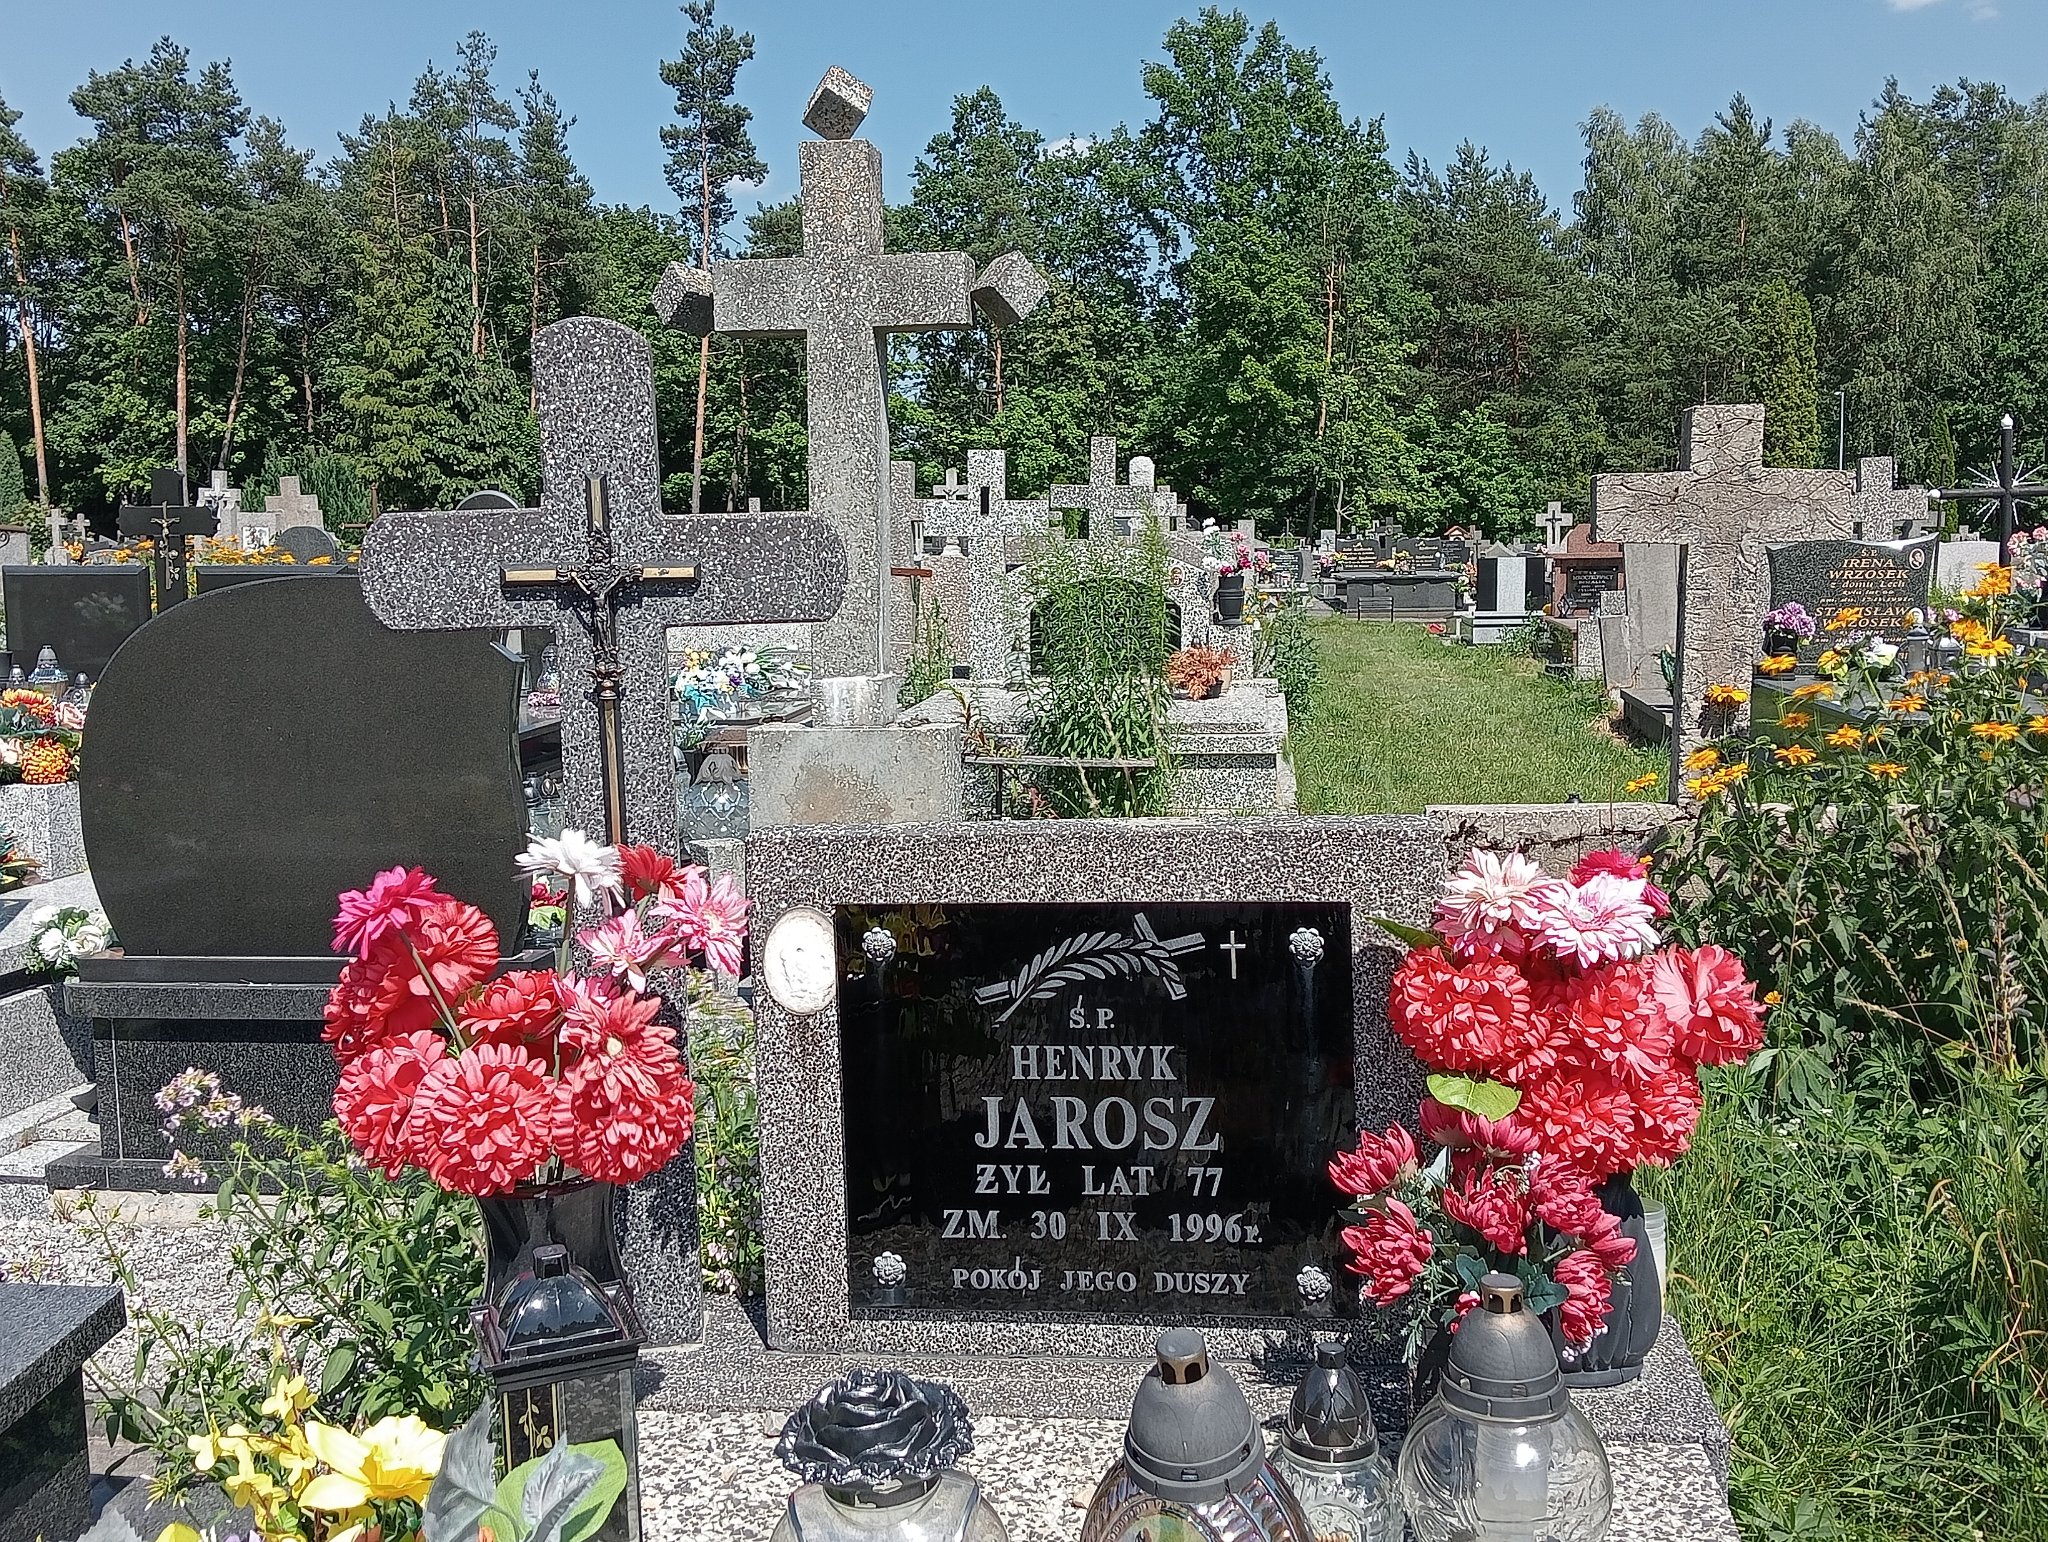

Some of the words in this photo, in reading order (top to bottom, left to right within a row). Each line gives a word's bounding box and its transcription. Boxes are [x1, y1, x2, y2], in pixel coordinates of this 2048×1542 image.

[1842, 558, 1895, 568] IRENA
[1828, 569, 1910, 579] WRZOSEK
[1842, 580, 1873, 588] domu
[1880, 580, 1905, 588] Lech
[1815, 606, 1910, 617] STAISŁAW
[1822, 617, 1902, 628] WZOSEK
[1010, 1045, 1177, 1081] HENRYK
[974, 1096, 1221, 1151] JAROSZ
[1081, 1165, 1155, 1196] LAT
[1187, 1166, 1223, 1197] 77
[941, 1209, 1008, 1239] ZM.
[1030, 1210, 1067, 1240] 30
[1096, 1211, 1139, 1241] IX
[951, 1256, 1042, 1291] POKÓJ
[1060, 1267, 1137, 1292] JEGO
[1153, 1271, 1250, 1295] DUSZY
